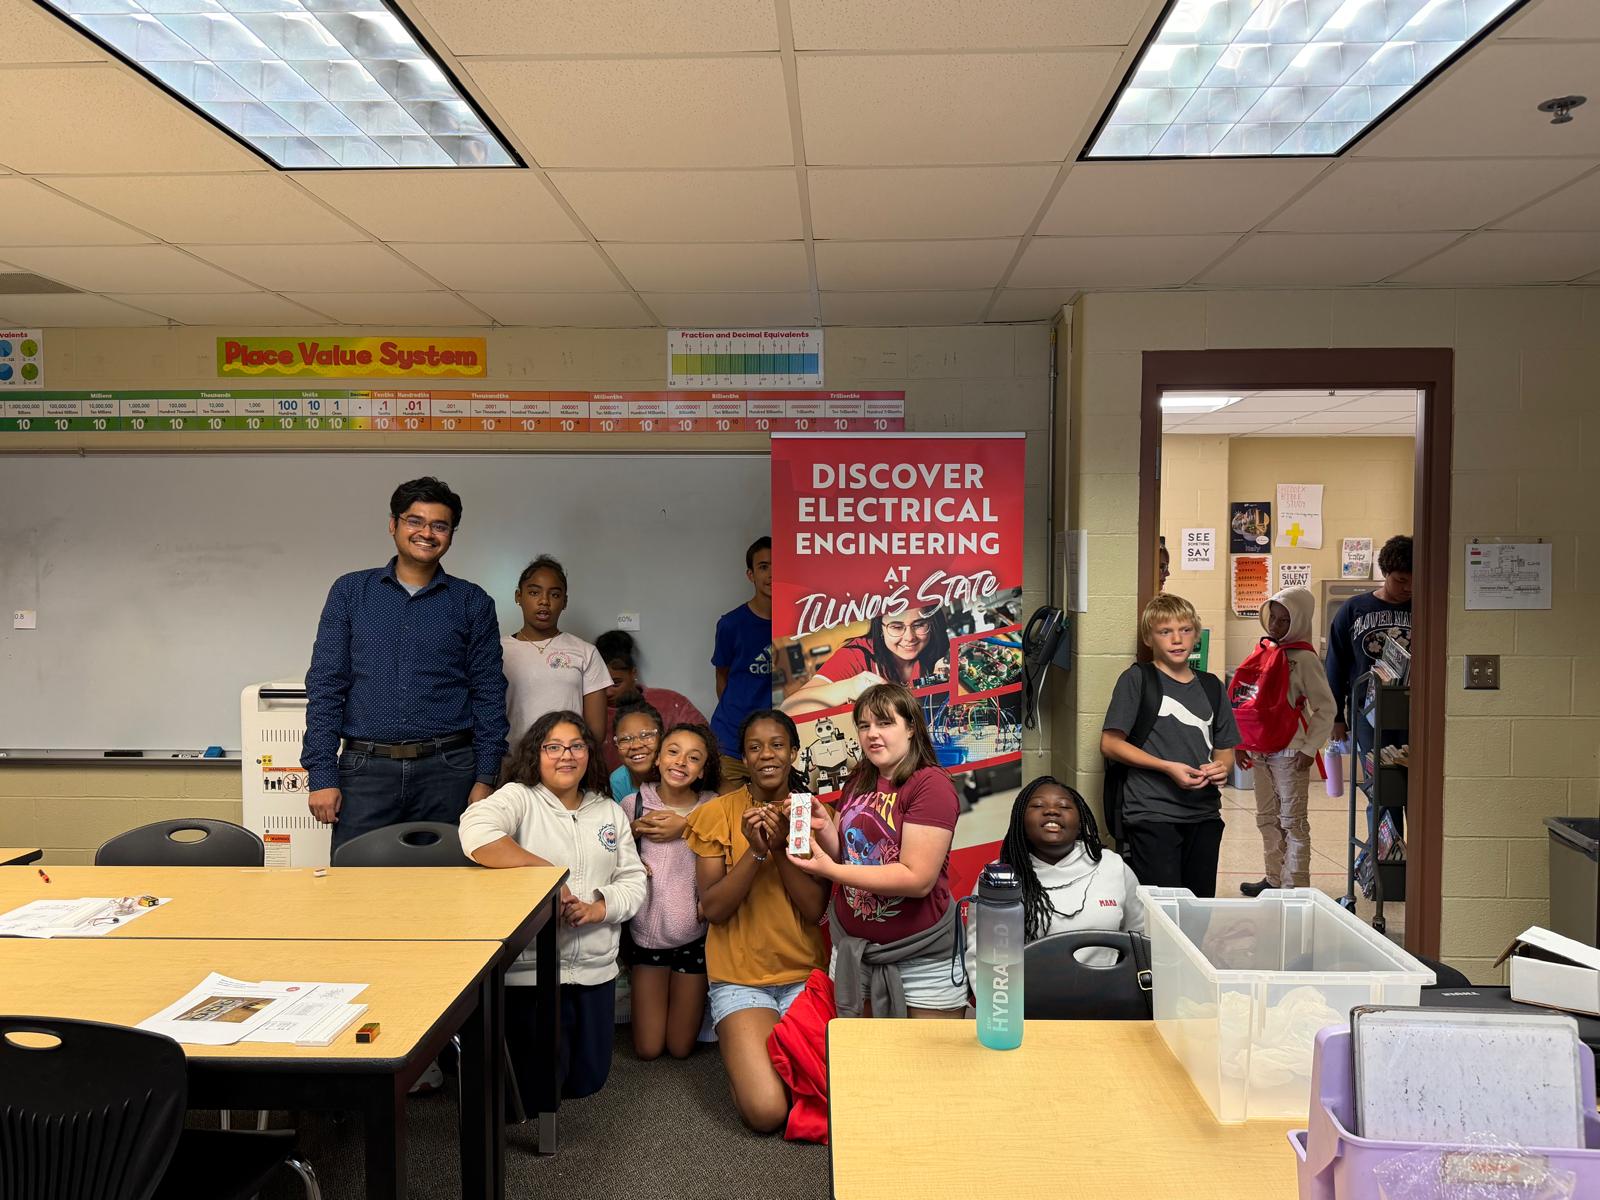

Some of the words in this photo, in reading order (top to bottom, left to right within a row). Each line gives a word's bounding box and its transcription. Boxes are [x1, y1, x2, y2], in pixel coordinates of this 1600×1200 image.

[764, 331, 809, 340] Equivalents
[224, 340, 294, 366] Place
[298, 342, 373, 366] Value
[379, 342, 478, 370] System
[278, 400, 298, 410] 100
[308, 400, 320, 410] 10
[334, 400, 339, 410] 1
[380, 400, 388, 411] .1
[405, 400, 422, 411] .01
[812, 463, 984, 489] DISCOVER
[798, 497, 999, 522] ELECTRICAL
[1188, 533, 1210, 542] SEE
[796, 532, 1000, 555] ENGINEERING
[1188, 548, 1210, 556] SAY
[884, 566, 911, 582] AT
